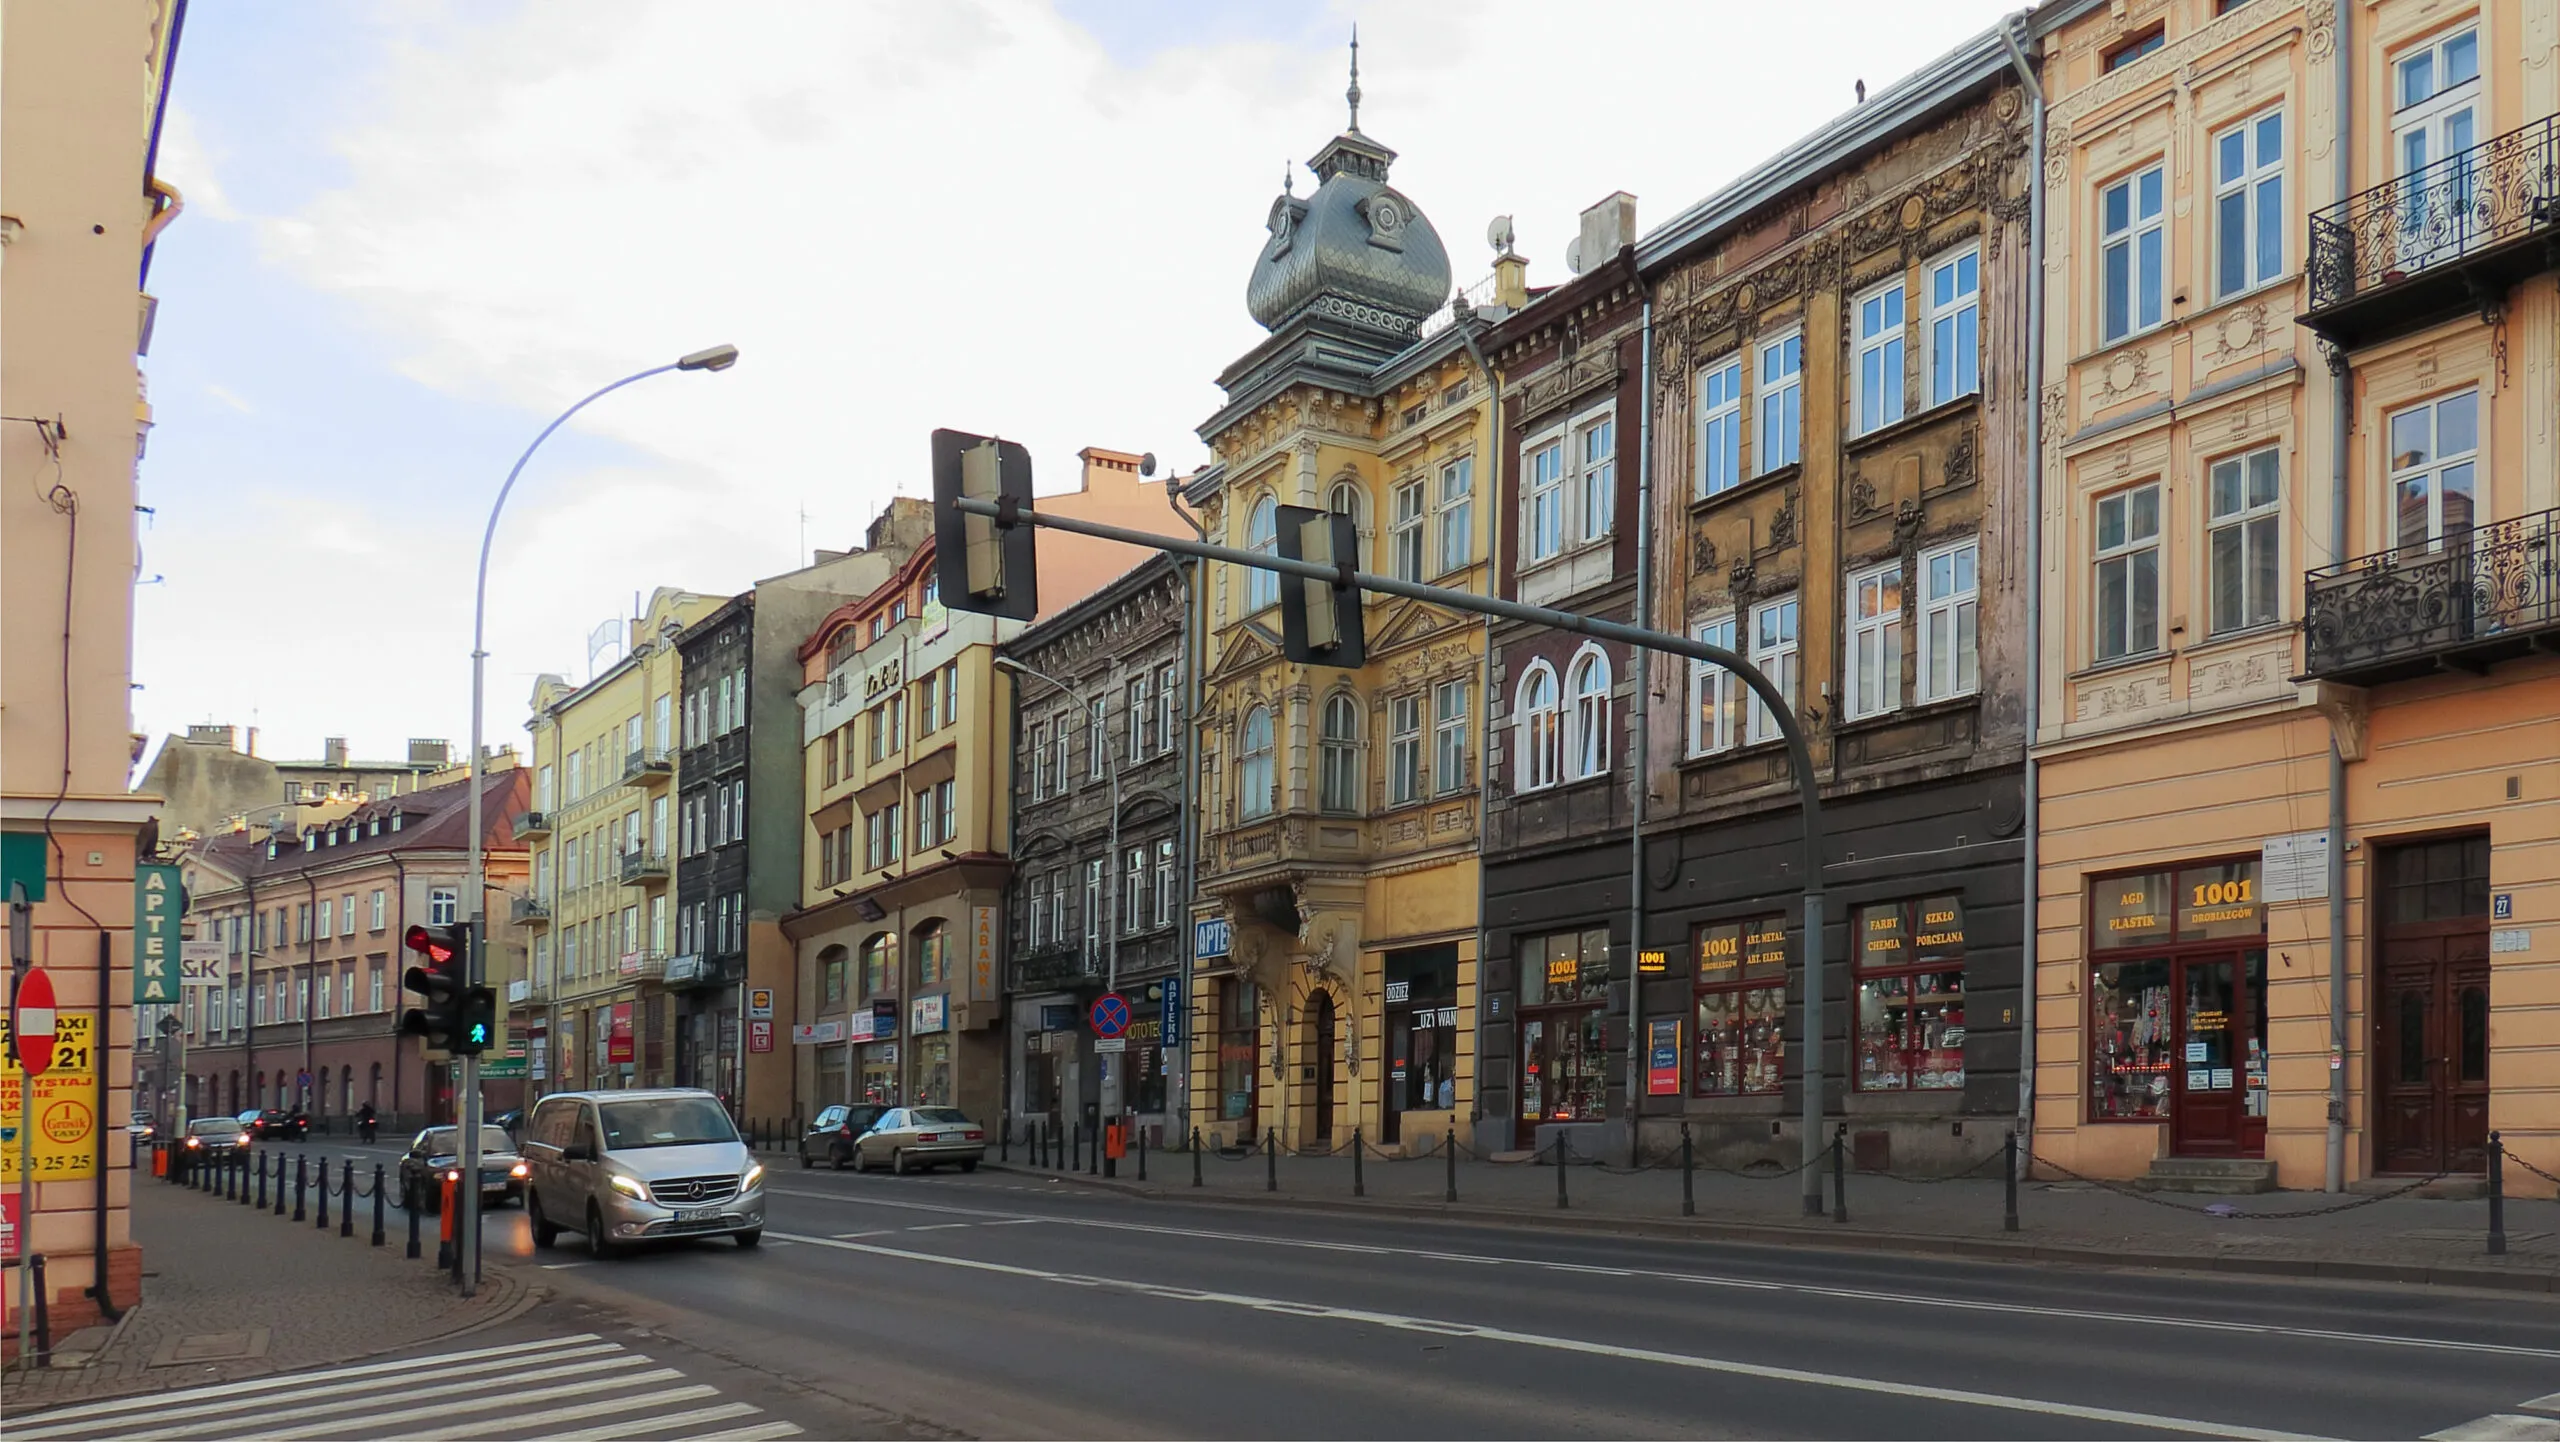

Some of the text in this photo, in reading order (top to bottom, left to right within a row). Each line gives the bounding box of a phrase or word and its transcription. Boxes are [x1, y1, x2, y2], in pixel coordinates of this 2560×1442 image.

[2120, 892, 2144, 906] AGD
[2192, 879, 2253, 907] 1001
[2496, 900, 2508, 914] 27
[1870, 918, 1898, 931] FARBY
[1925, 911, 1954, 924] SZKŁO
[2109, 915, 2155, 931] PLASTIK
[145, 872, 166, 998] APTEKA
[1198, 921, 1231, 955] APTE
[1916, 931, 1963, 946] PORCELANA
[1702, 937, 1737, 957] 1001
[1868, 939, 1900, 952] CHEMIA
[977, 911, 991, 1000] ZABAWKI
[1640, 952, 1665, 963] 1001
[1549, 960, 1577, 975] 1001
[1167, 981, 1178, 1044] APTEKA
[56, 1018, 88, 1030] AXI
[63, 1105, 71, 1120] 1
[52, 1130, 80, 1138] TAXI
[44, 1156, 65, 1171] 25
[70, 1155, 91, 1170] 25
